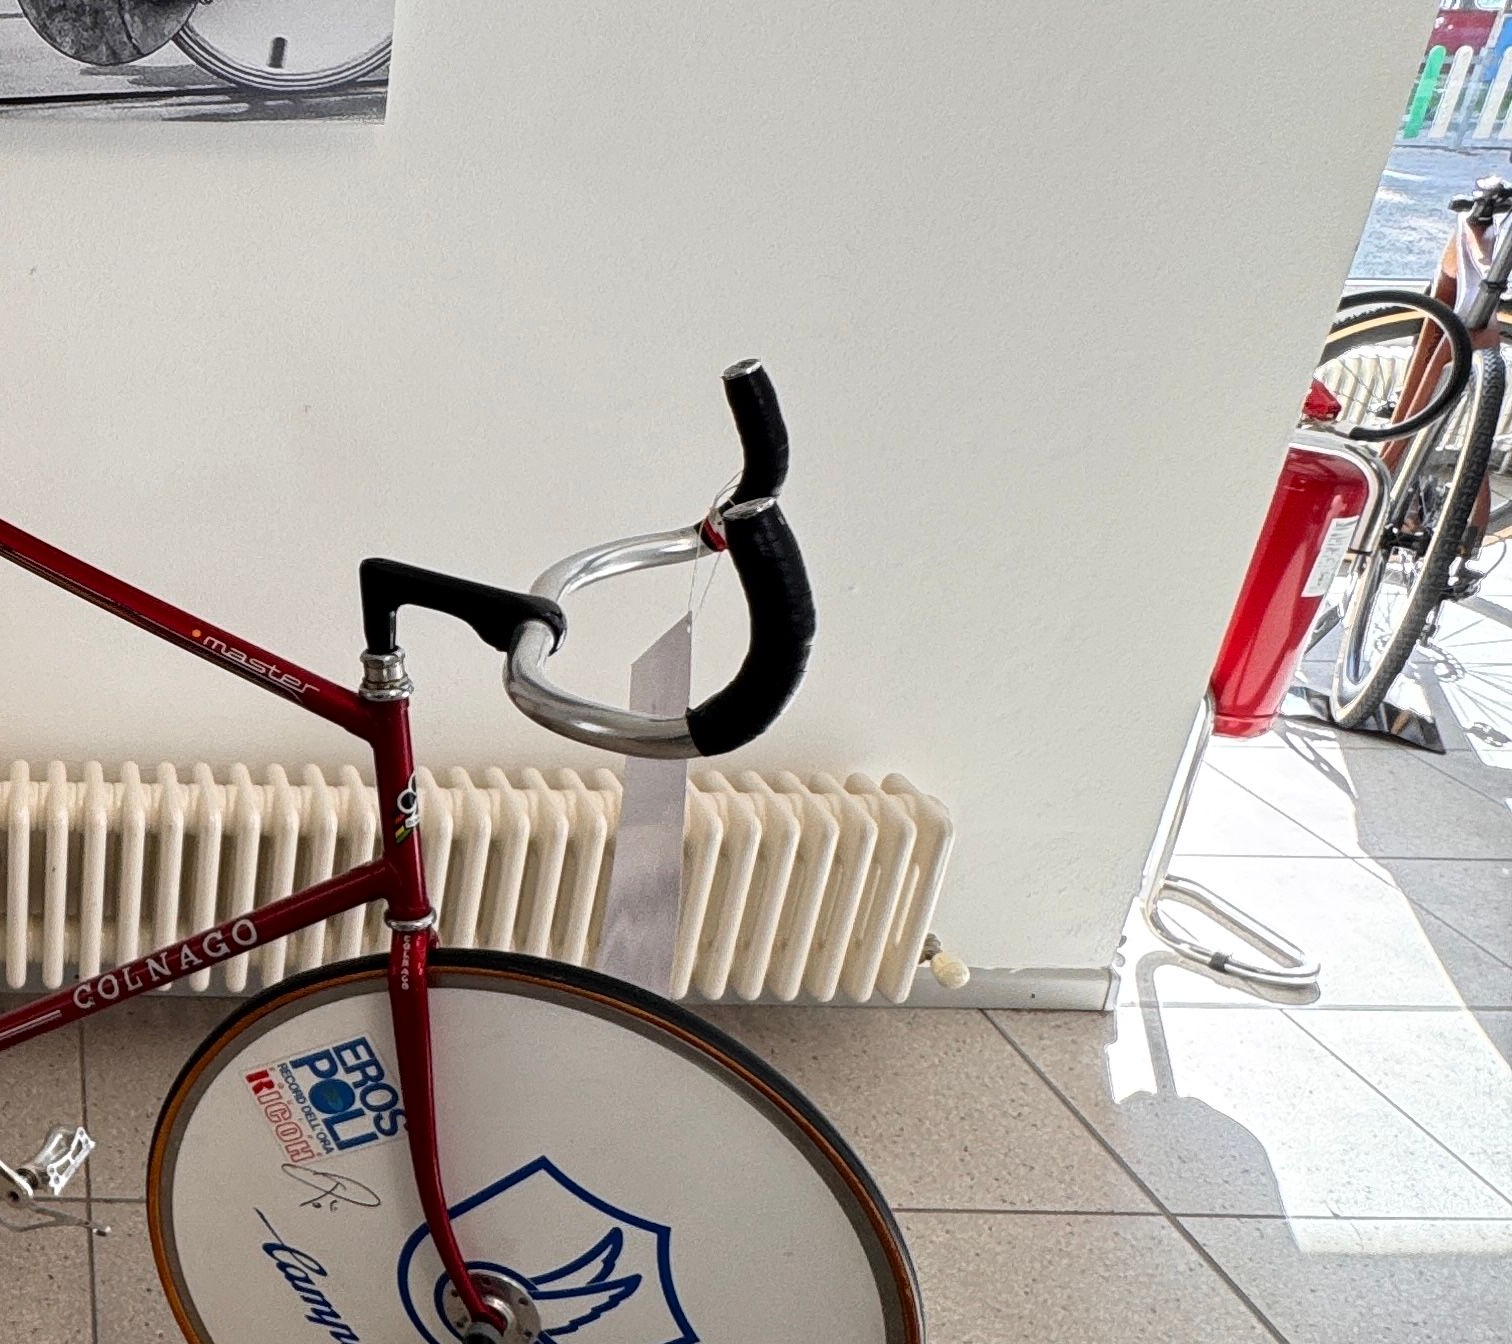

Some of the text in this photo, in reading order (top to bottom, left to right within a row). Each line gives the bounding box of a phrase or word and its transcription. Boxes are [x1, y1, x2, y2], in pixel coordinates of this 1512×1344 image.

[203, 635, 319, 694] master
[73, 918, 258, 1009] COLNAGO
[245, 1069, 316, 1163] RICOH
[277, 1062, 306, 1105] RECORD
[289, 1049, 379, 1151] POLI
[332, 1036, 408, 1137] EROS
